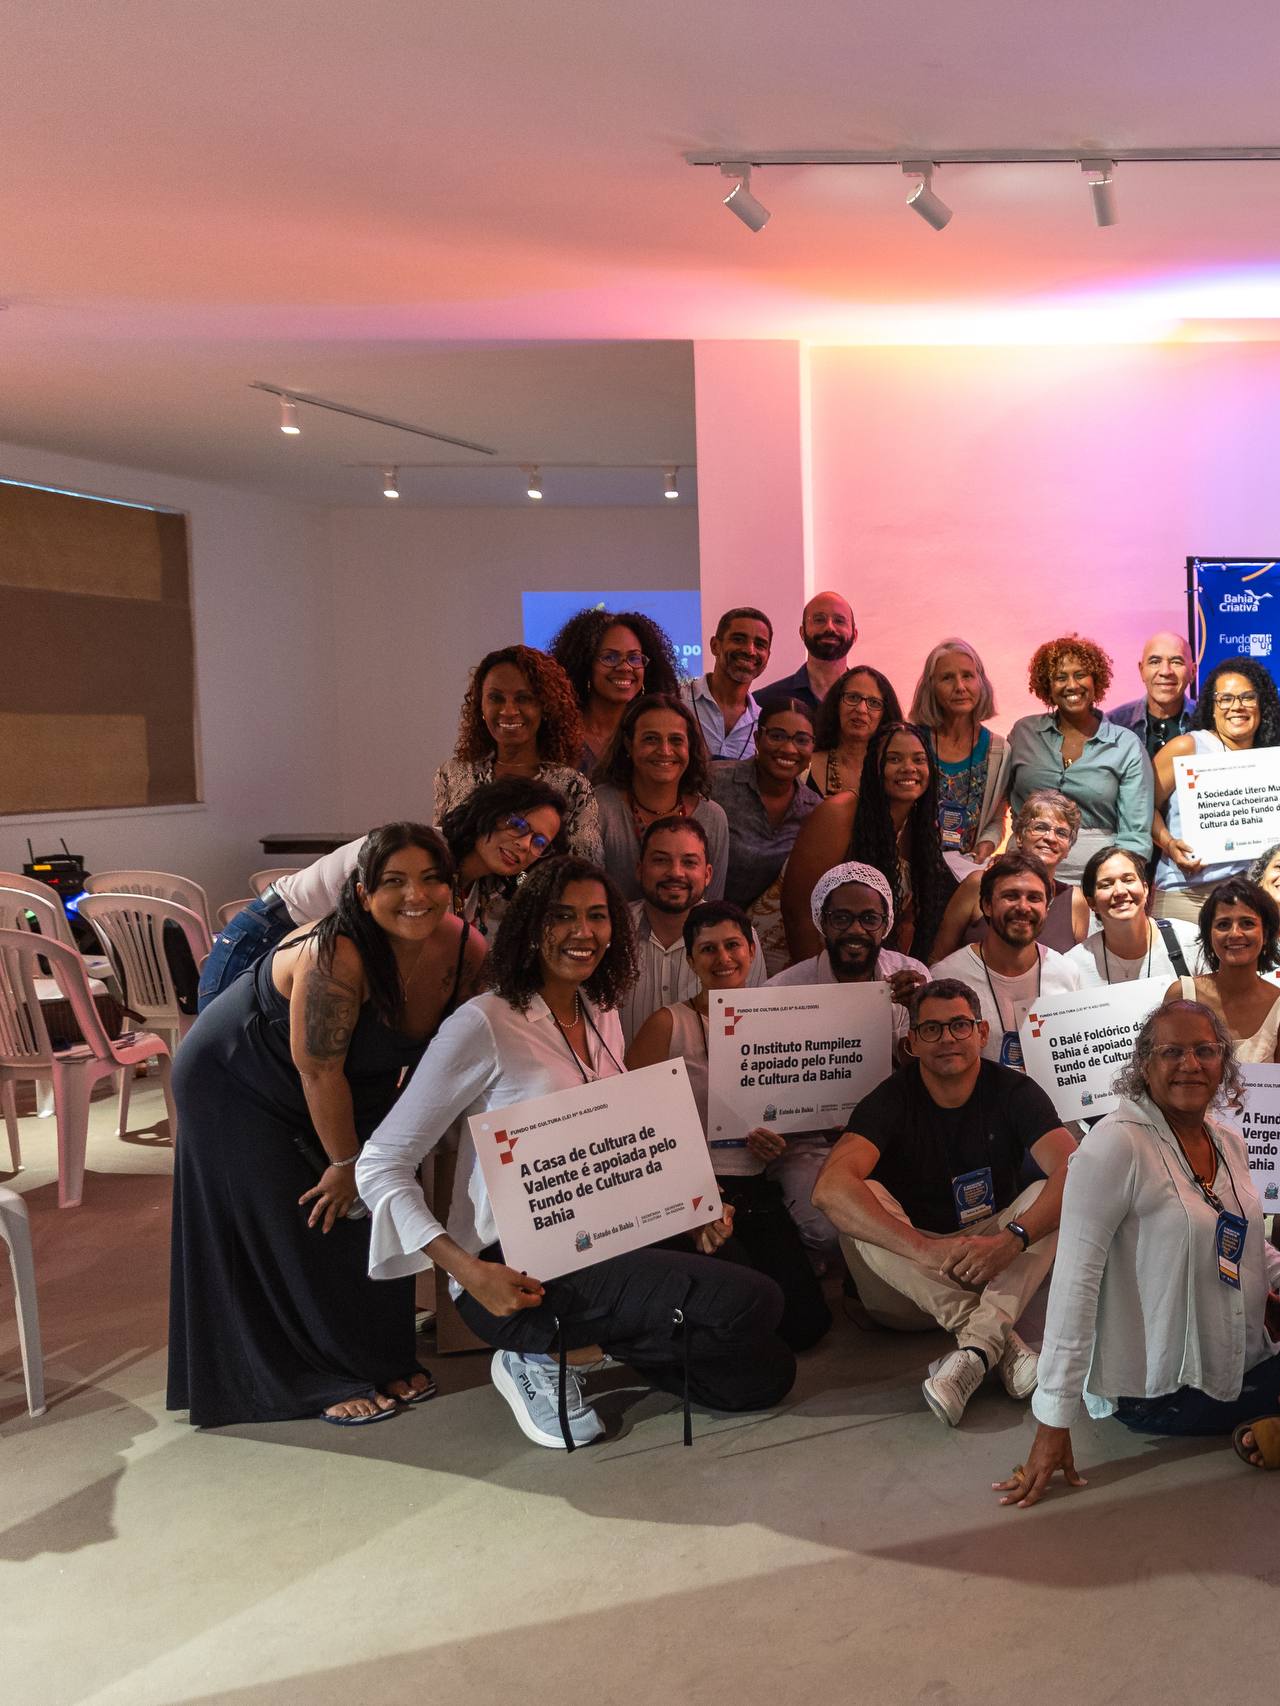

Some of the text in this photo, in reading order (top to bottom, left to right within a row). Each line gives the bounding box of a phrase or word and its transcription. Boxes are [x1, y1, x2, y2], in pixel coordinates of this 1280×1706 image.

[1219, 602, 1259, 612] Criativa
[1224, 593, 1253, 603] Bahia
[1219, 633, 1250, 644] Fundo
[1238, 644, 1250, 653] de
[1198, 801, 1230, 809] Minerva
[1232, 796, 1278, 806] Cachoeirana
[1204, 788, 1243, 799] Sociedade
[1199, 809, 1231, 820] apoiada
[1232, 807, 1249, 817] pelo
[1251, 805, 1274, 814] Fundo
[1200, 816, 1263, 830] Cultura da Bahia
[1049, 1022, 1144, 1048] O Balé Folclórico da
[741, 1037, 862, 1056] O Instituto Rumpilezz
[1051, 1037, 1132, 1061] Bahia é apoiado
[740, 1051, 863, 1073] é apoiado pelo Fundo
[1054, 1051, 1134, 1074] Fundo de Cultur
[740, 1067, 852, 1087] de Cultura da Bahia
[1056, 1073, 1087, 1087] Bahia
[510, 1126, 529, 1136] FUNDO
[537, 1117, 562, 1128] CULTURA
[1243, 1112, 1251, 1124] A
[521, 1126, 656, 1178] A Casa de Cultura de
[1247, 1143, 1278, 1156] undo
[523, 1137, 677, 1195] Valente é apoiada pelo
[1248, 1158, 1275, 1170] ahia
[528, 1160, 663, 1213] Fundo de Cultura da
[533, 1207, 575, 1231] Bahia
[593, 1221, 634, 1240] Estado da Bahia
[519, 1372, 536, 1401] FILA
